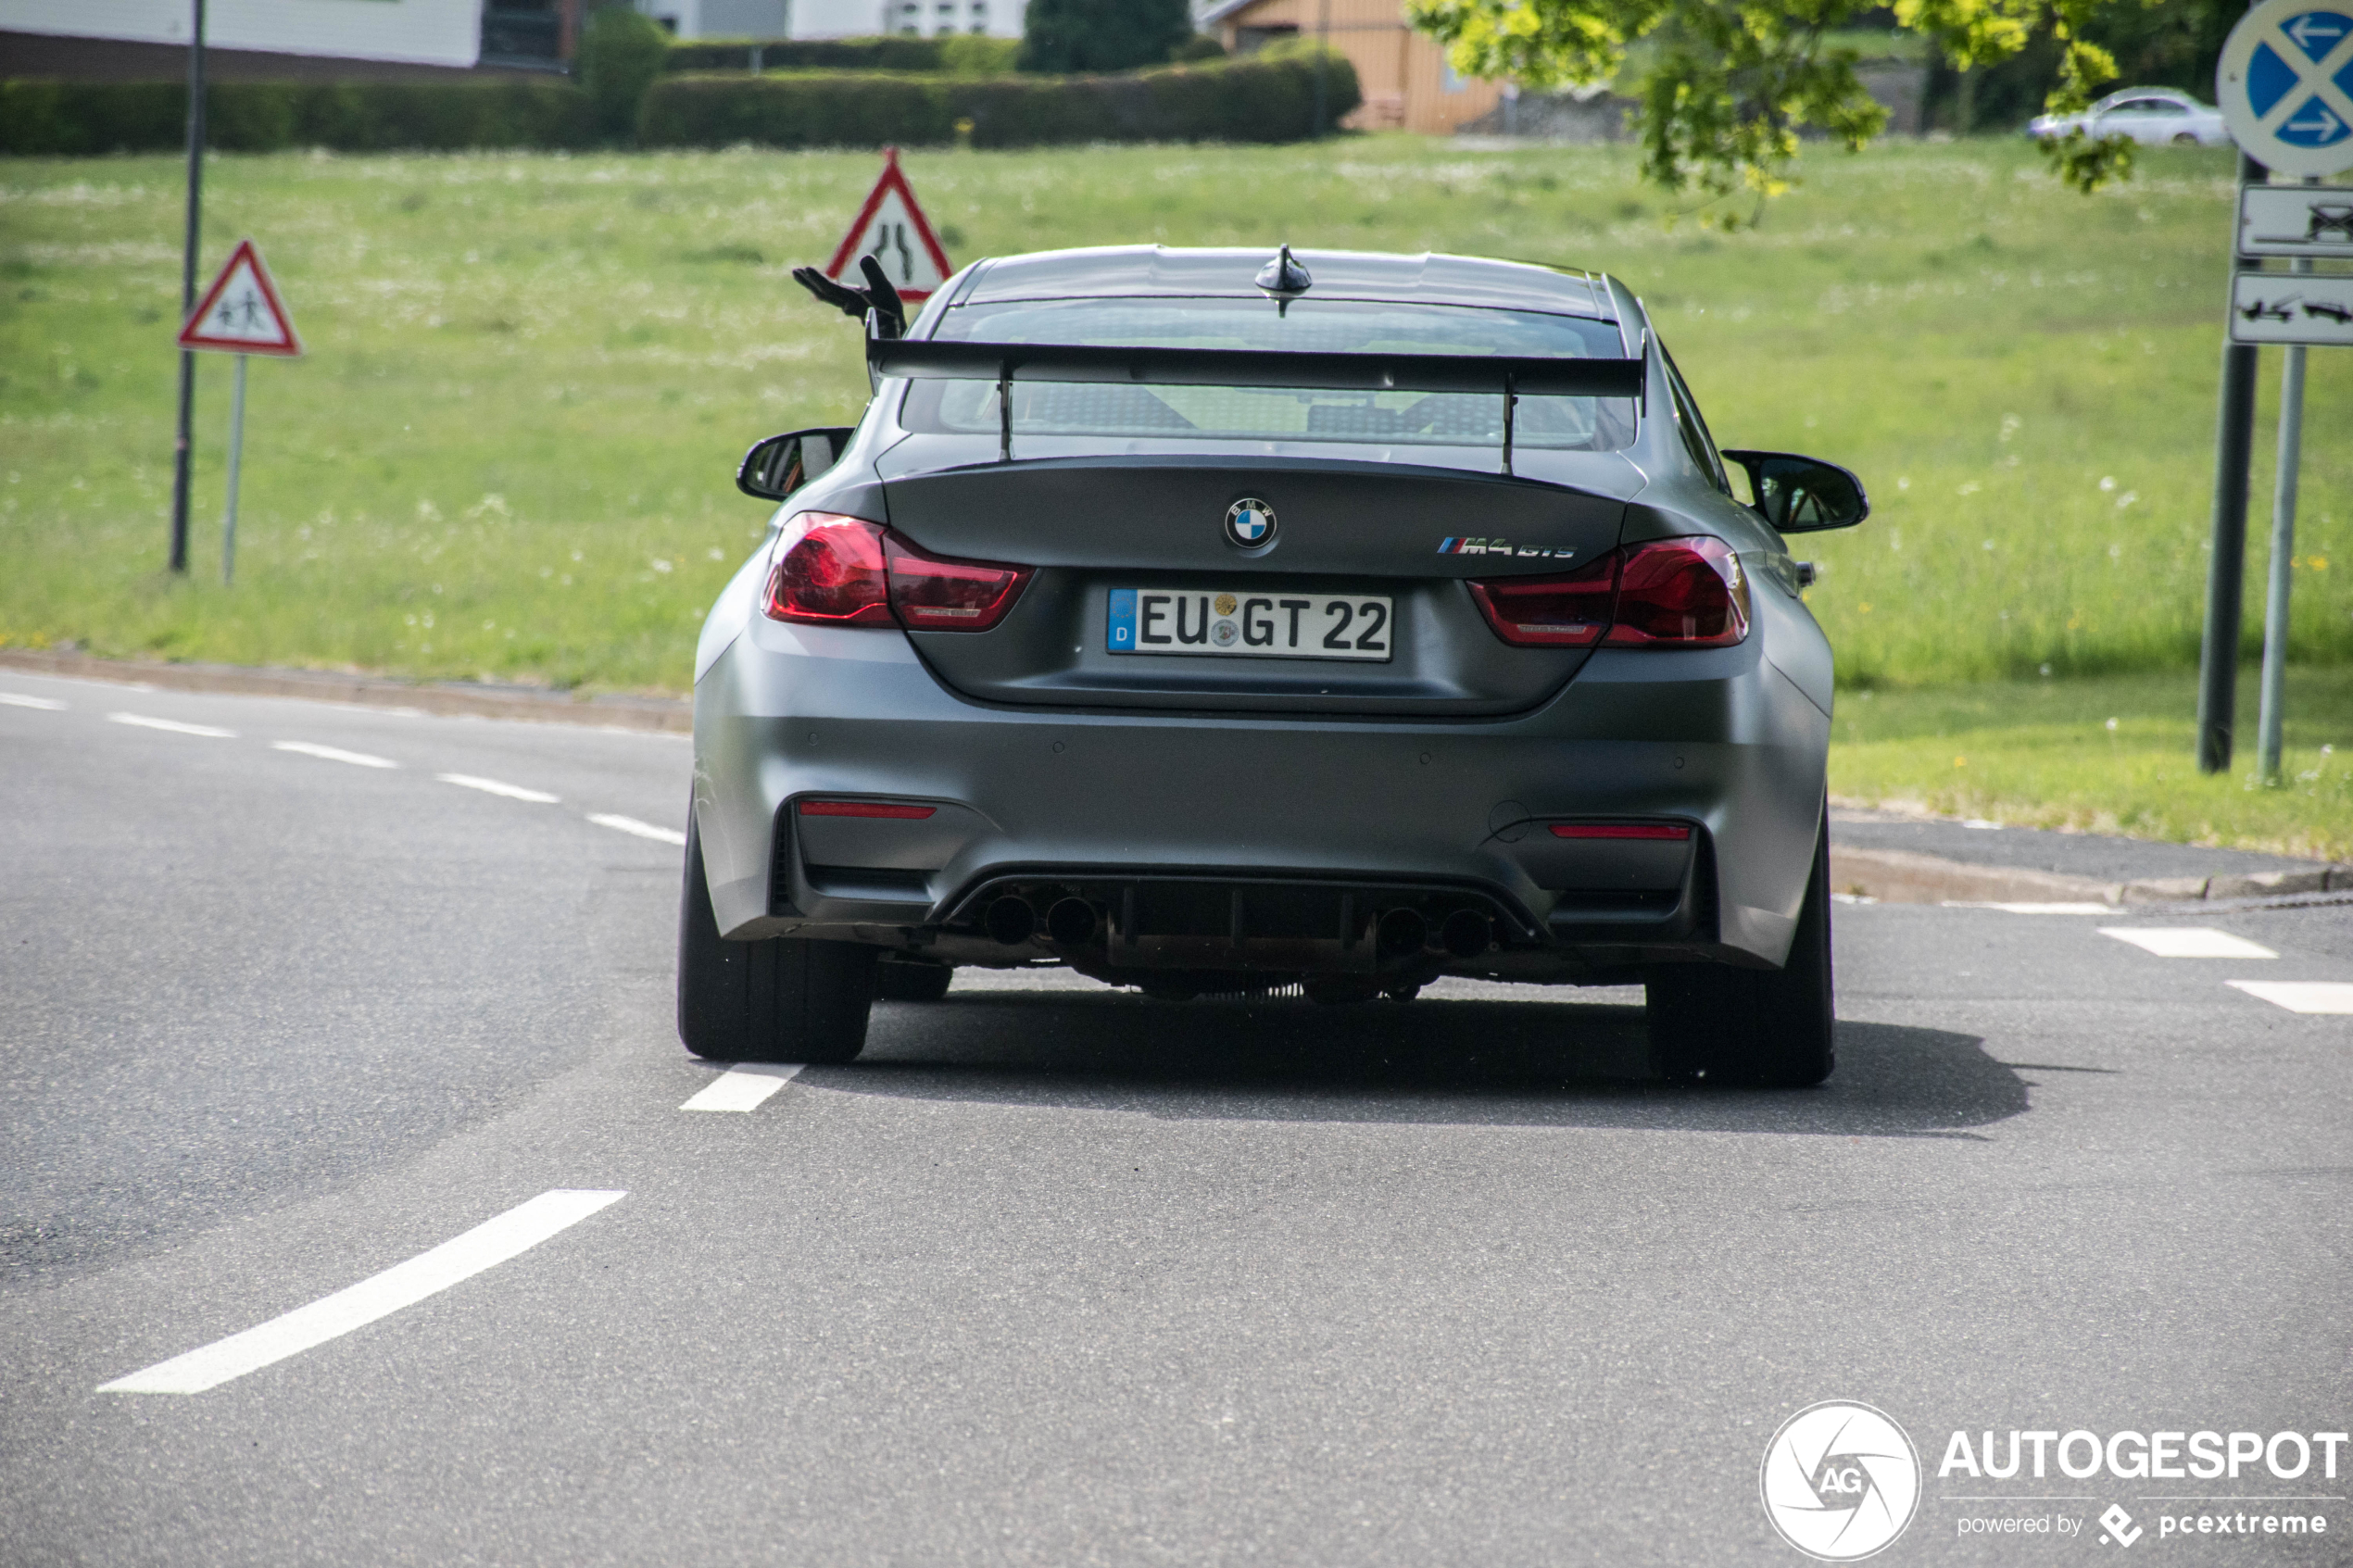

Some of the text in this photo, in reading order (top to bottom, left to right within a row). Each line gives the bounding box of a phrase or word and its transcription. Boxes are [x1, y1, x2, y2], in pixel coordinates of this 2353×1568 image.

[1230, 500, 1274, 517] BMW
[1458, 537, 1579, 558] M4 GTS
[1140, 596, 1209, 645] EU
[1242, 598, 1311, 647] GT
[1323, 601, 1388, 651] 22
[1115, 627, 1128, 642] D
